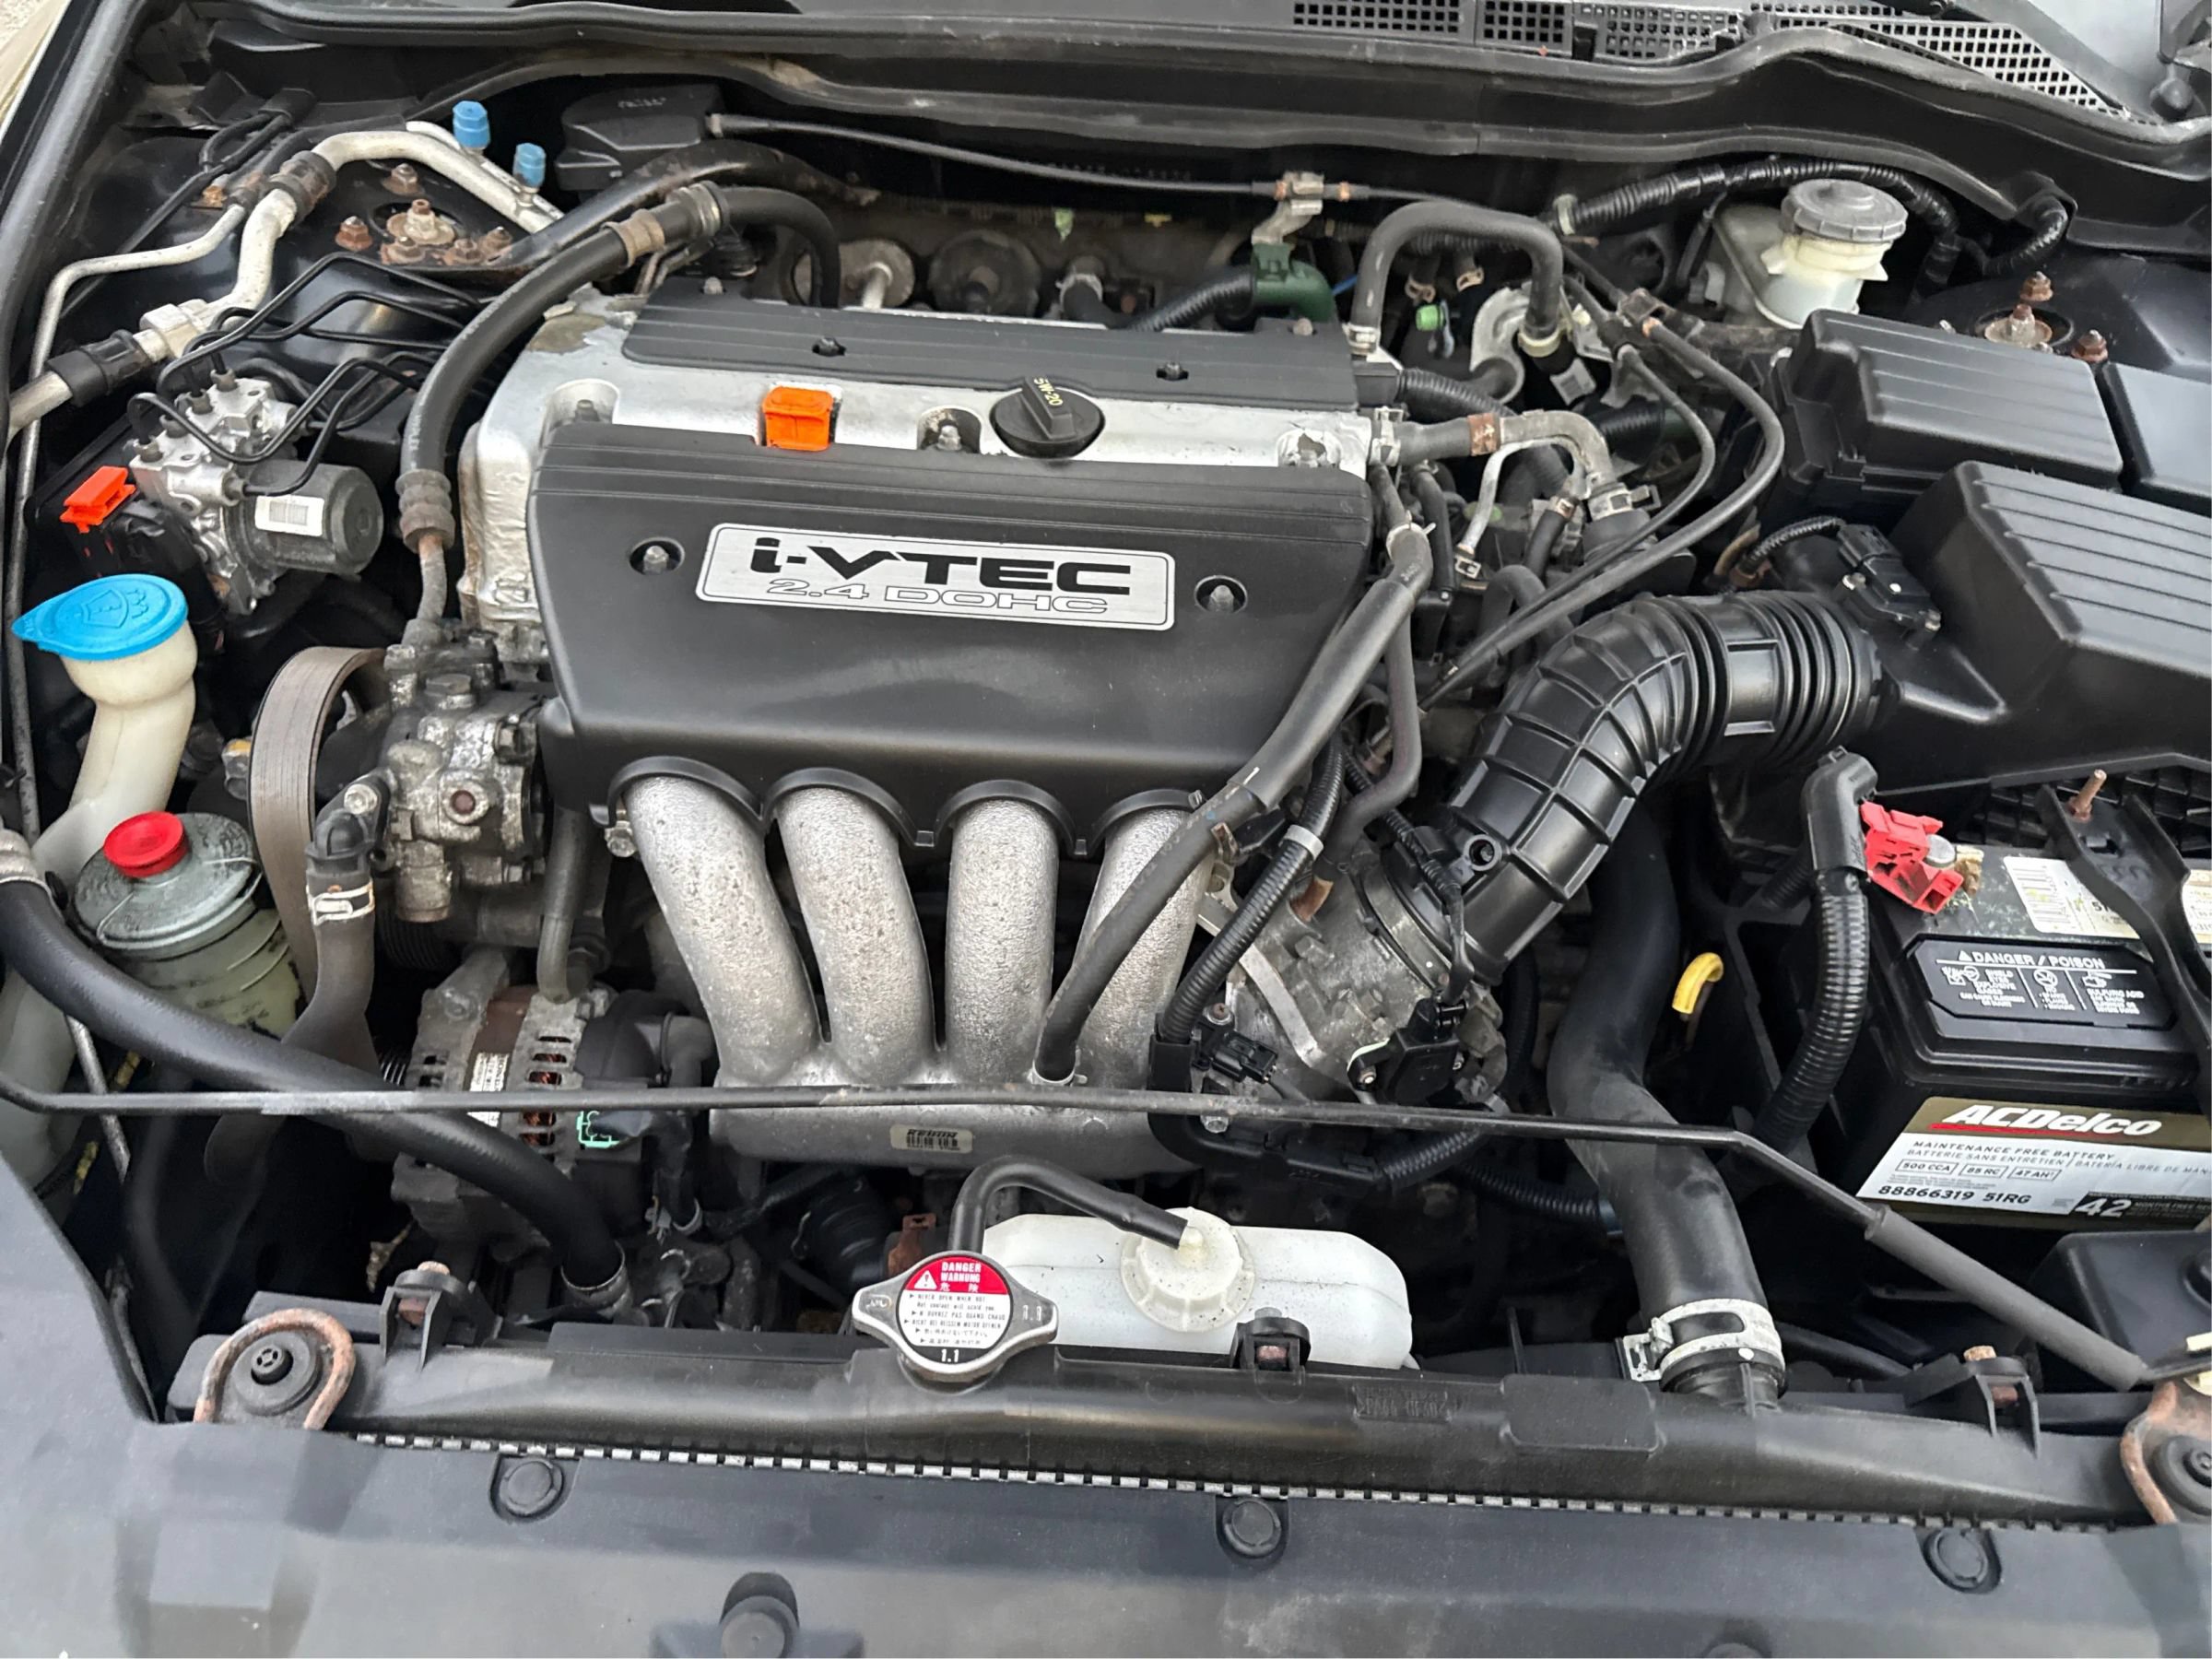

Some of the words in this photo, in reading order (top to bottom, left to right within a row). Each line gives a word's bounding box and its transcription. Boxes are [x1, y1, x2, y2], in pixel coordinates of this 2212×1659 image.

[1033, 377, 1064, 406] 5W-20
[749, 537, 1131, 595] i-VTEC
[767, 579, 870, 600] 2.4
[884, 586, 1108, 613] DOHC
[1972, 951, 2035, 965] DANGER
[2038, 955, 2045, 966] /
[2049, 956, 2105, 969] POISON
[1942, 1104, 2162, 1136] ACDelco
[1913, 1141, 2011, 1153] MAINTENANCE
[2053, 1150, 2114, 1159] BATTERY
[1907, 1149, 1962, 1159] BATTERIE
[1966, 1154, 1997, 1162] SANS
[2000, 1156, 2065, 1165] ENTRETIEN
[2127, 1163, 2161, 1171] LIBRE
[1878, 1185, 1974, 1201] 88866319
[1983, 1192, 2032, 1204] 51RG
[2075, 1198, 2132, 1217] 42
[942, 1262, 982, 1272] DANGER
[941, 1348, 959, 1362] 1.1
